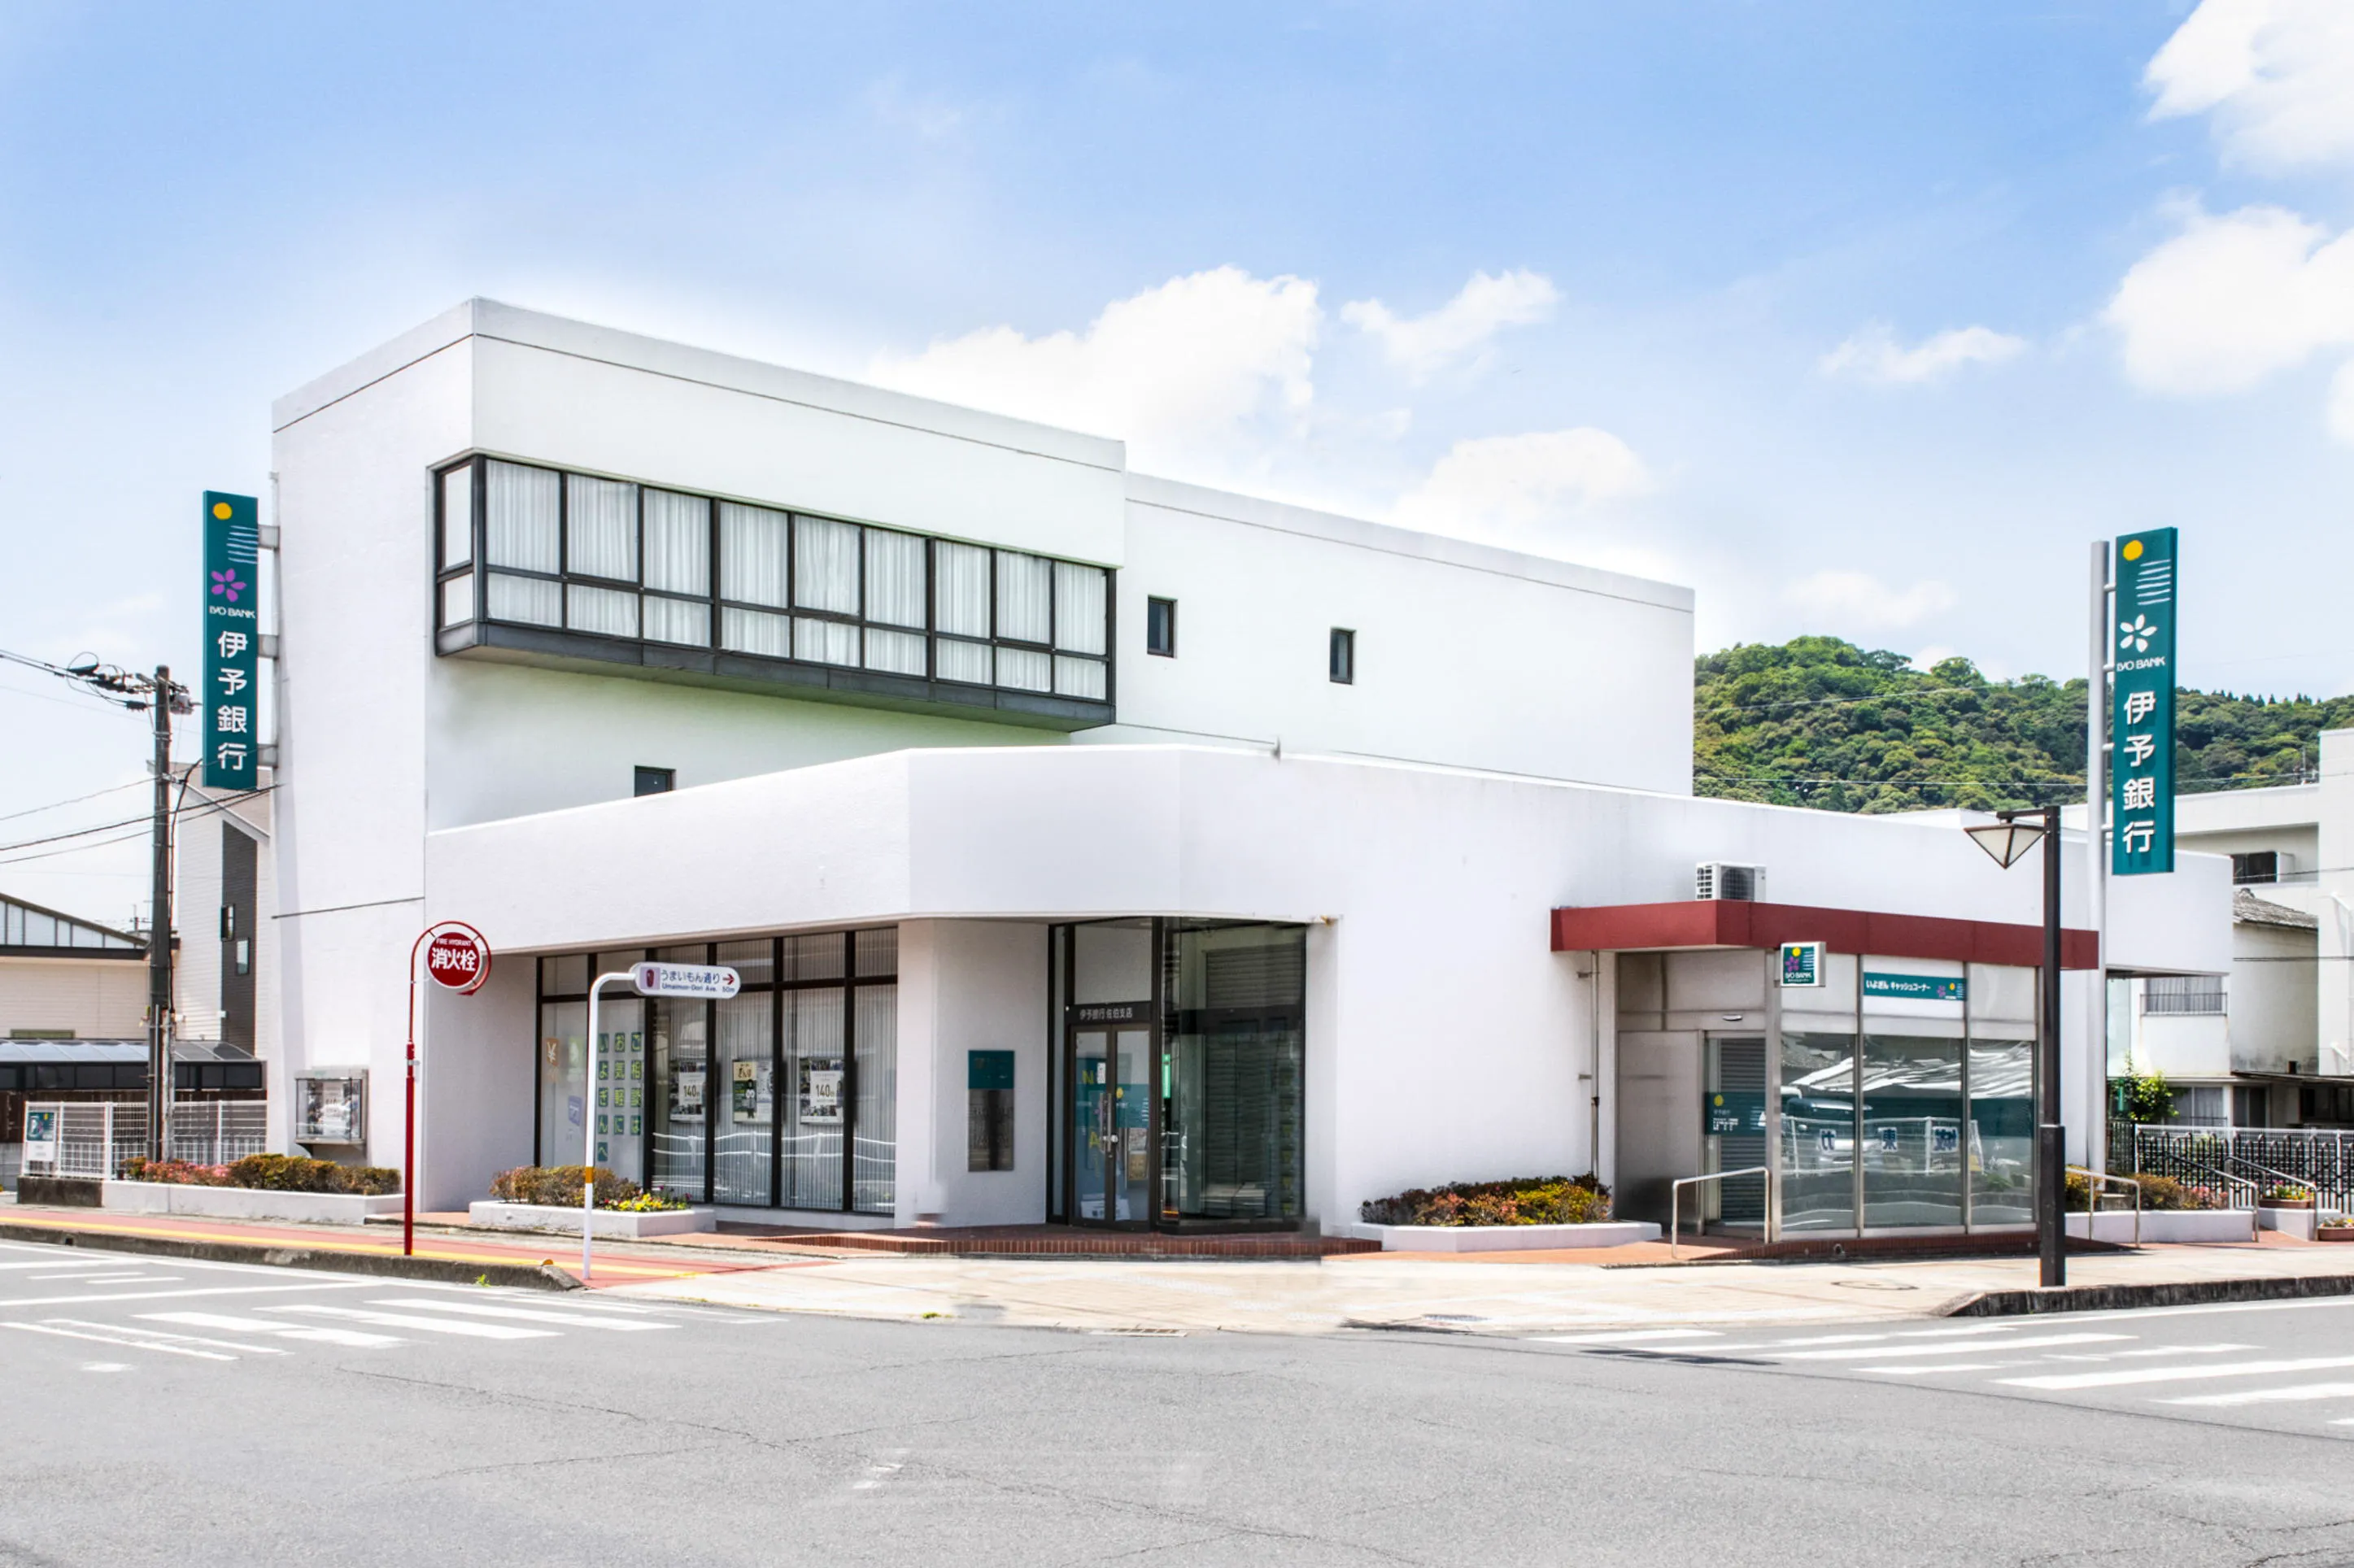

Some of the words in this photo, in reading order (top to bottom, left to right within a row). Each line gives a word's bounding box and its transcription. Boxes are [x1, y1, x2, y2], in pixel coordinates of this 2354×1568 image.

[209, 605, 226, 616] IYO
[228, 607, 255, 619] BANK
[2116, 660, 2134, 672] IYO
[2136, 656, 2165, 669] BANK
[217, 630, 248, 771] 伊予銀行
[2122, 690, 2156, 853] 伊予銀行
[431, 947, 477, 972] 消火栓
[660, 969, 720, 984] うまいもん通り
